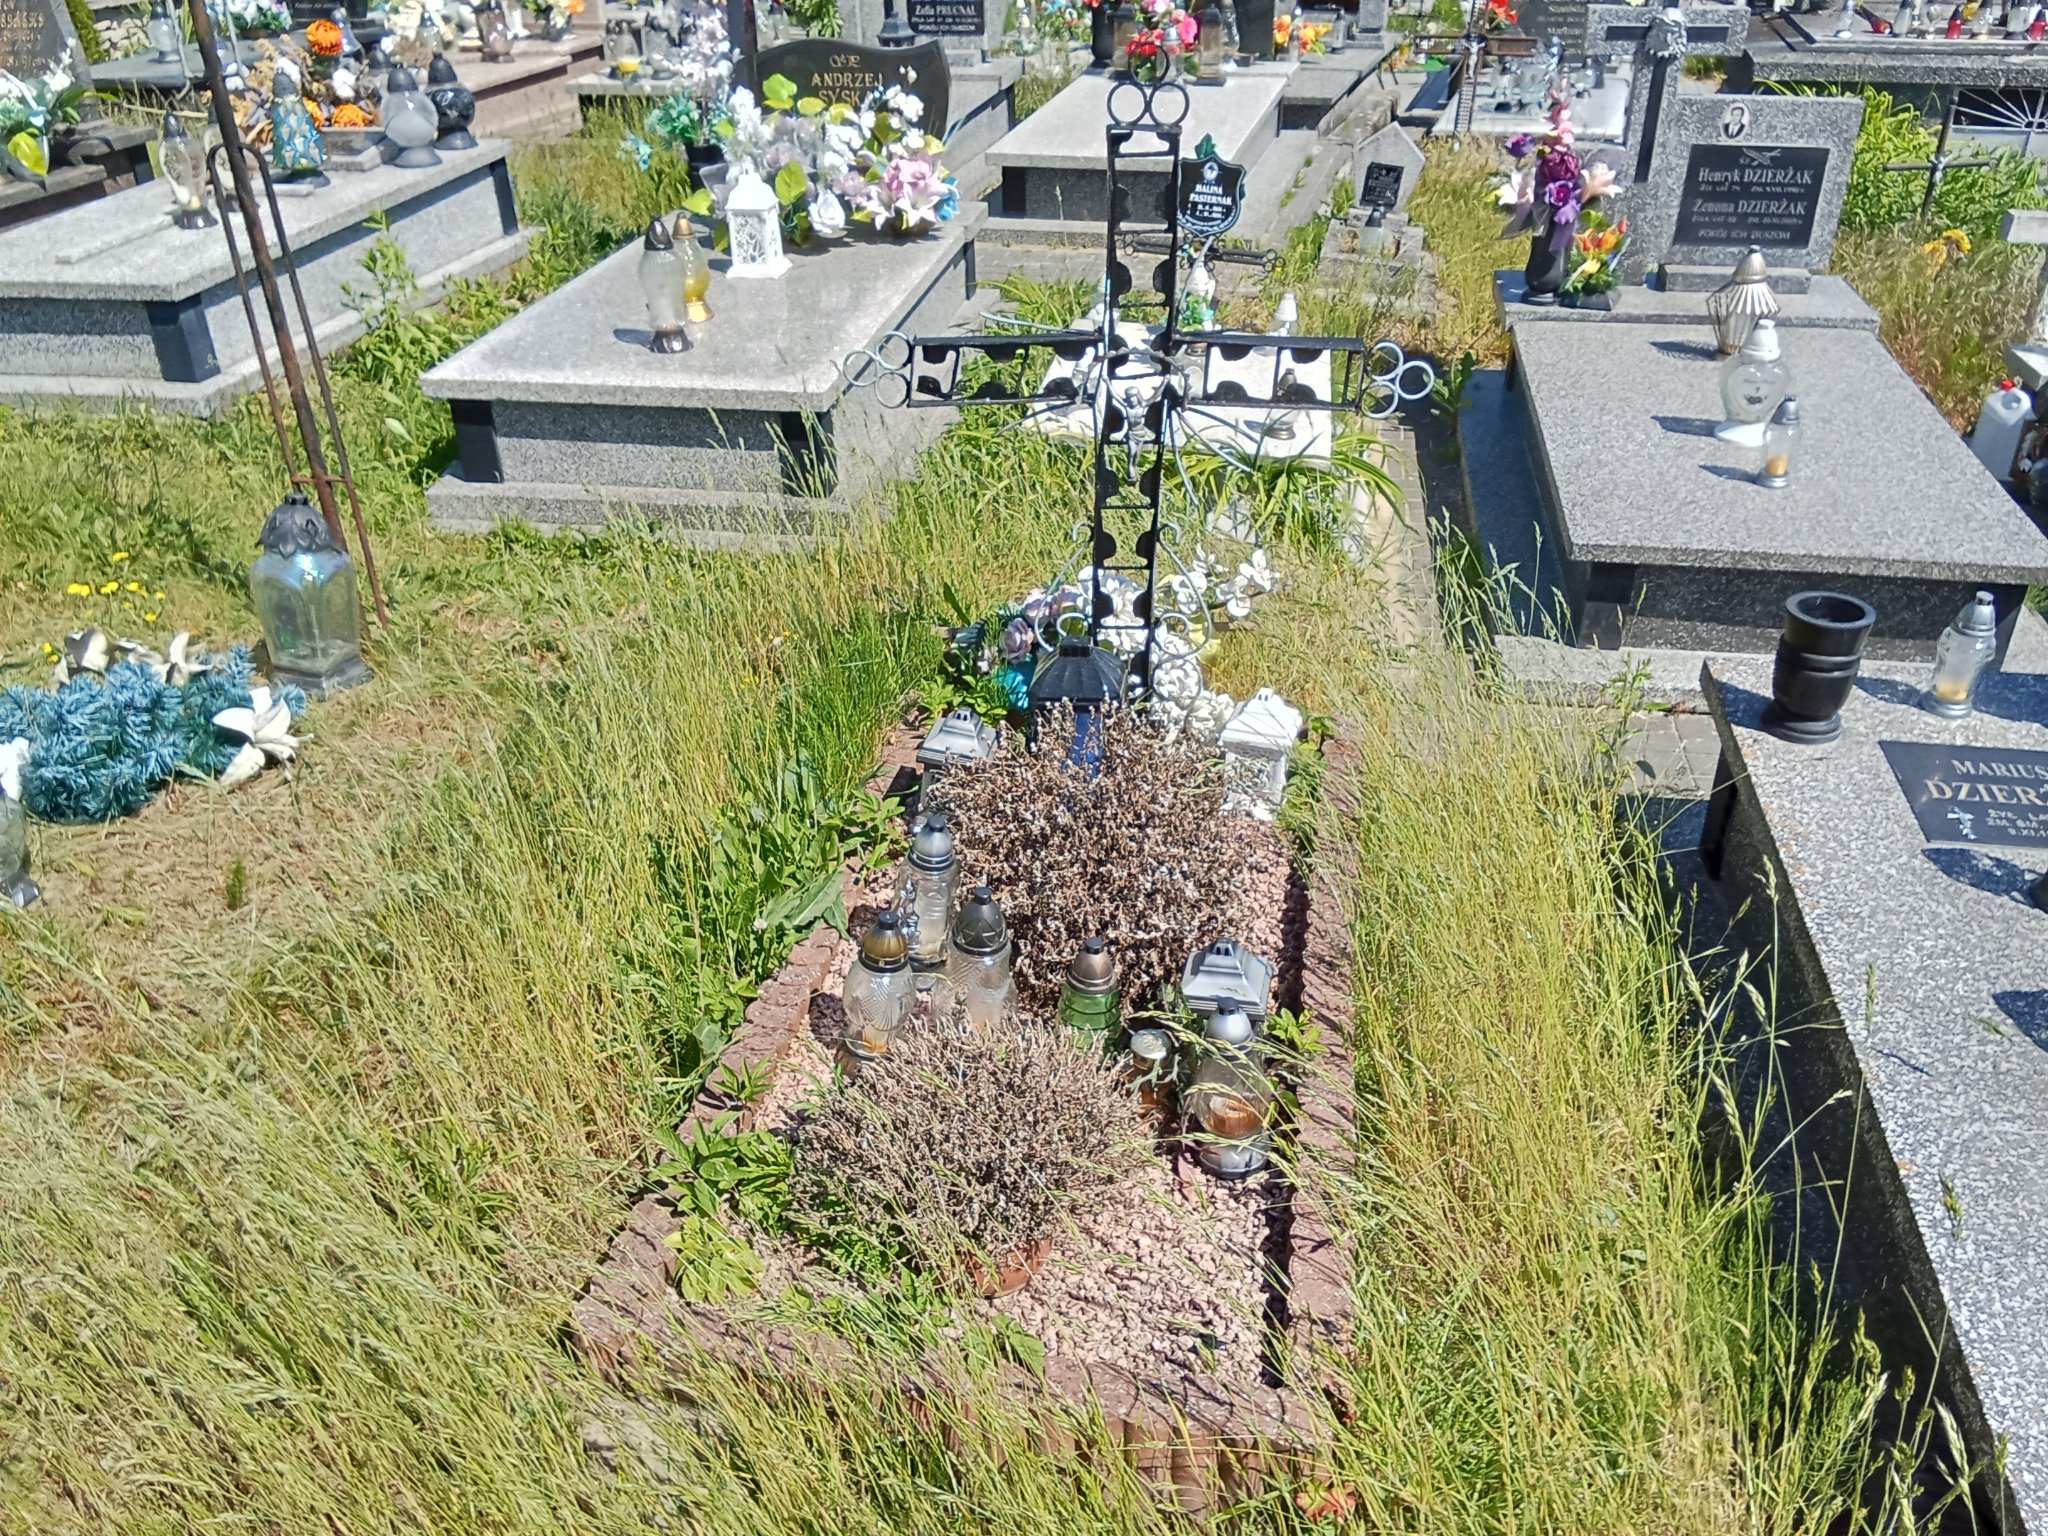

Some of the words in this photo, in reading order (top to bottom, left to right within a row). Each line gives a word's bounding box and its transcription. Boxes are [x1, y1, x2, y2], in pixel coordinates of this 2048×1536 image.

[811, 72, 883, 87] ANDRZEJ
[1698, 167, 1740, 184] Henryk
[1743, 166, 1814, 185] DZIERŻAK
[1693, 199, 1735, 214] Zenona
[1737, 198, 1808, 215] DZIERŻAK
[1951, 759, 2048, 780] MARIUS
